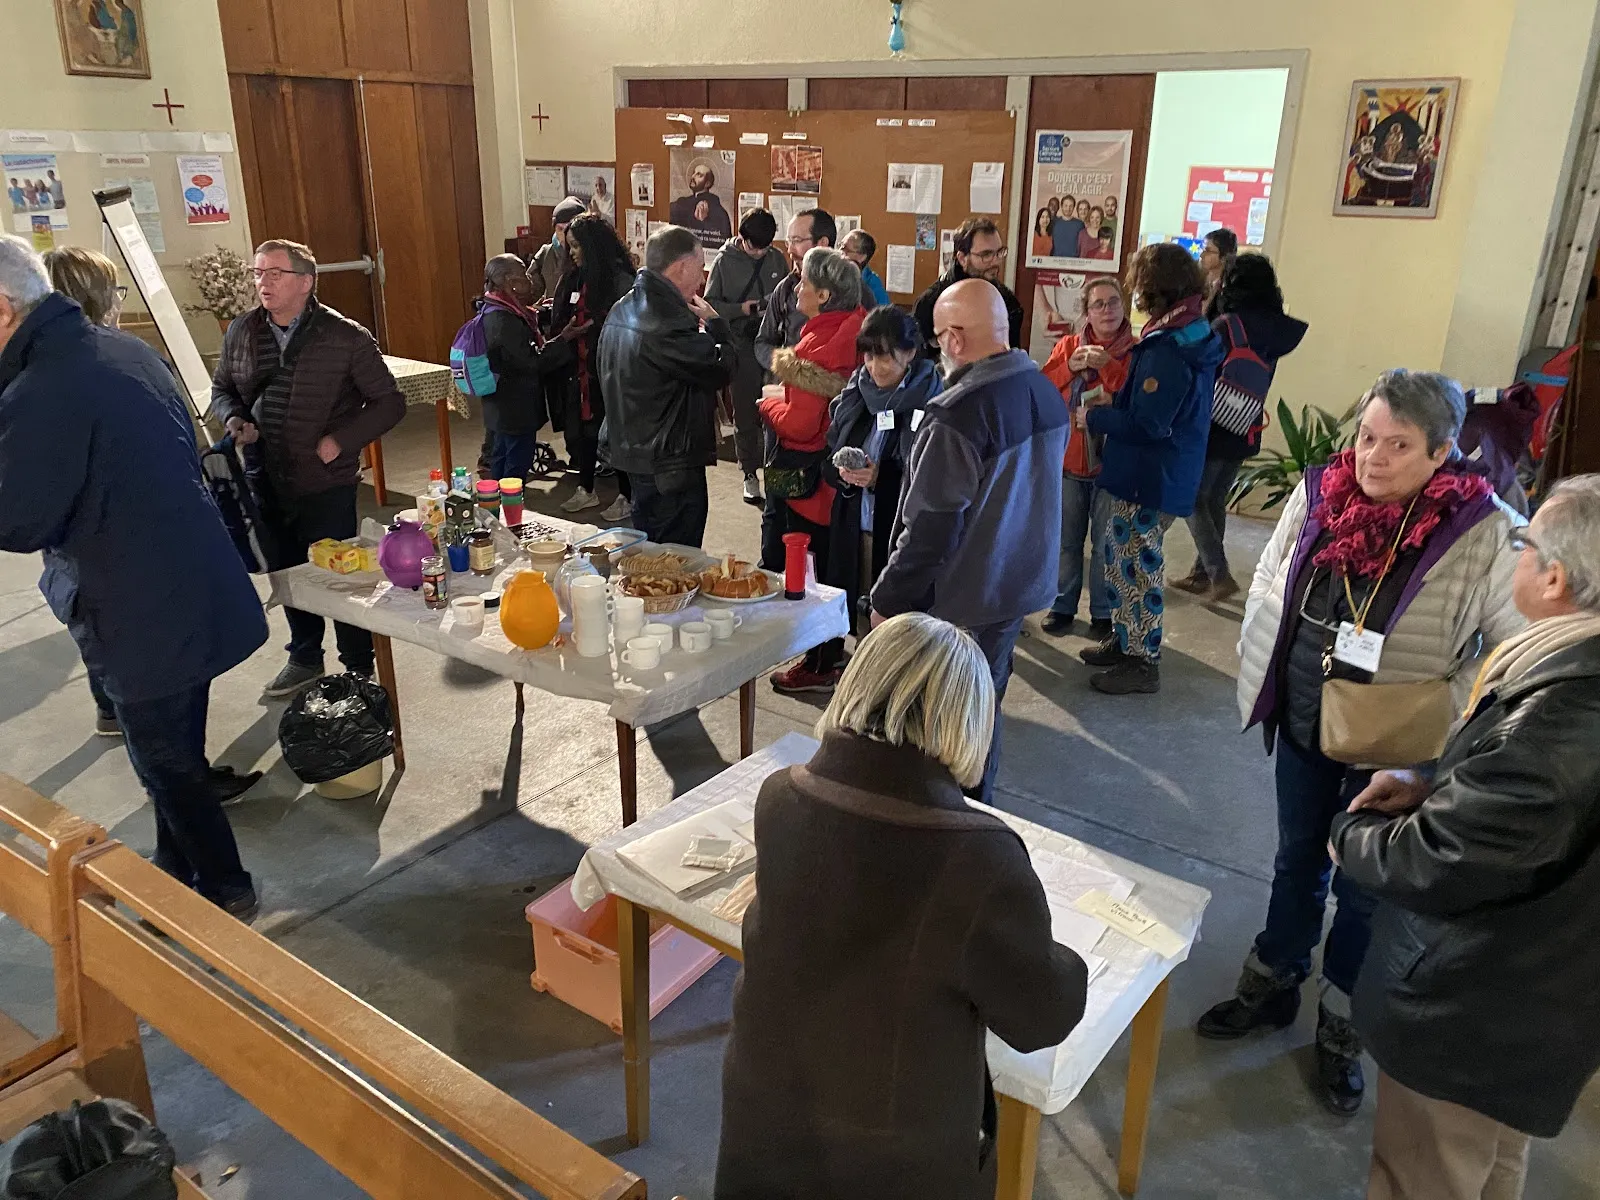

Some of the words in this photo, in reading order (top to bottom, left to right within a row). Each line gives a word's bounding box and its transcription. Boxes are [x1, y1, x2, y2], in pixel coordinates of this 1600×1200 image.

[1048, 171, 1083, 183] DONNER
[1086, 173, 1113, 184] C'EST
[1056, 182, 1078, 194] DÉJÀ
[1081, 185, 1102, 195] AGIR
